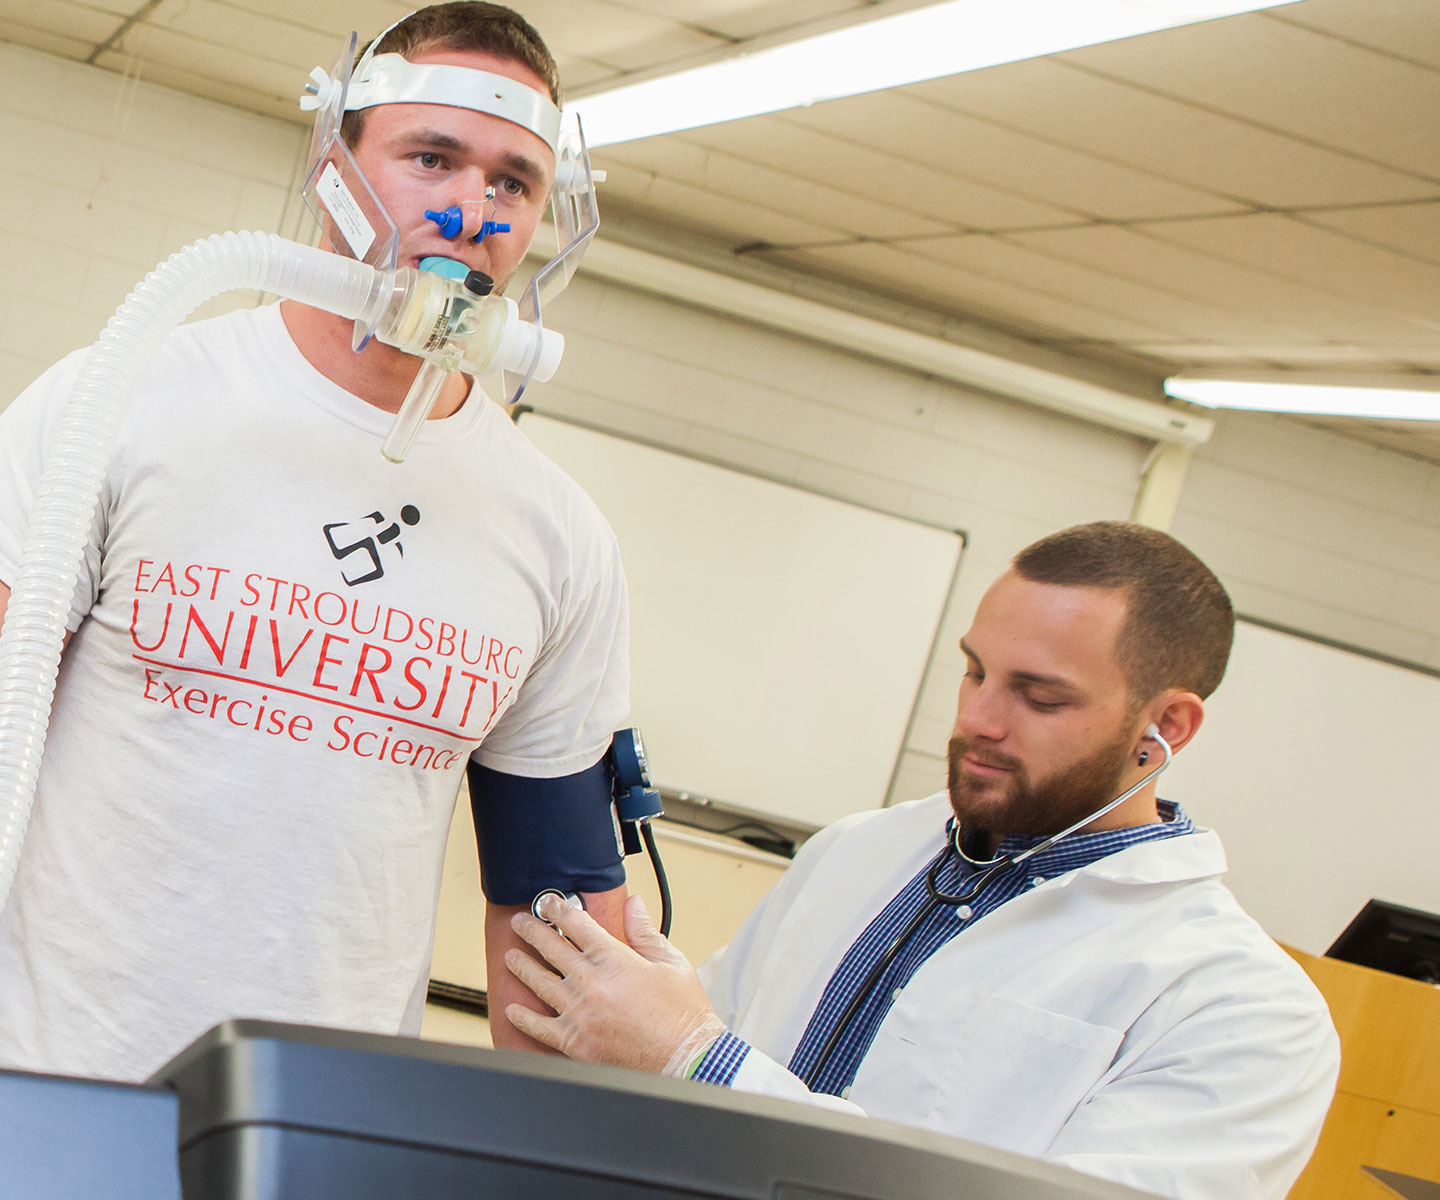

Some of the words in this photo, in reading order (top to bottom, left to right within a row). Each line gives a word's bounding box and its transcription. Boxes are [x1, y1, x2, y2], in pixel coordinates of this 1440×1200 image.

[130, 599, 513, 732] UNIVERSITY
[134, 559, 230, 601] EAST
[239, 573, 522, 680] STROUDSBURG
[143, 667, 314, 742] Exercise
[327, 715, 461, 770] Science
